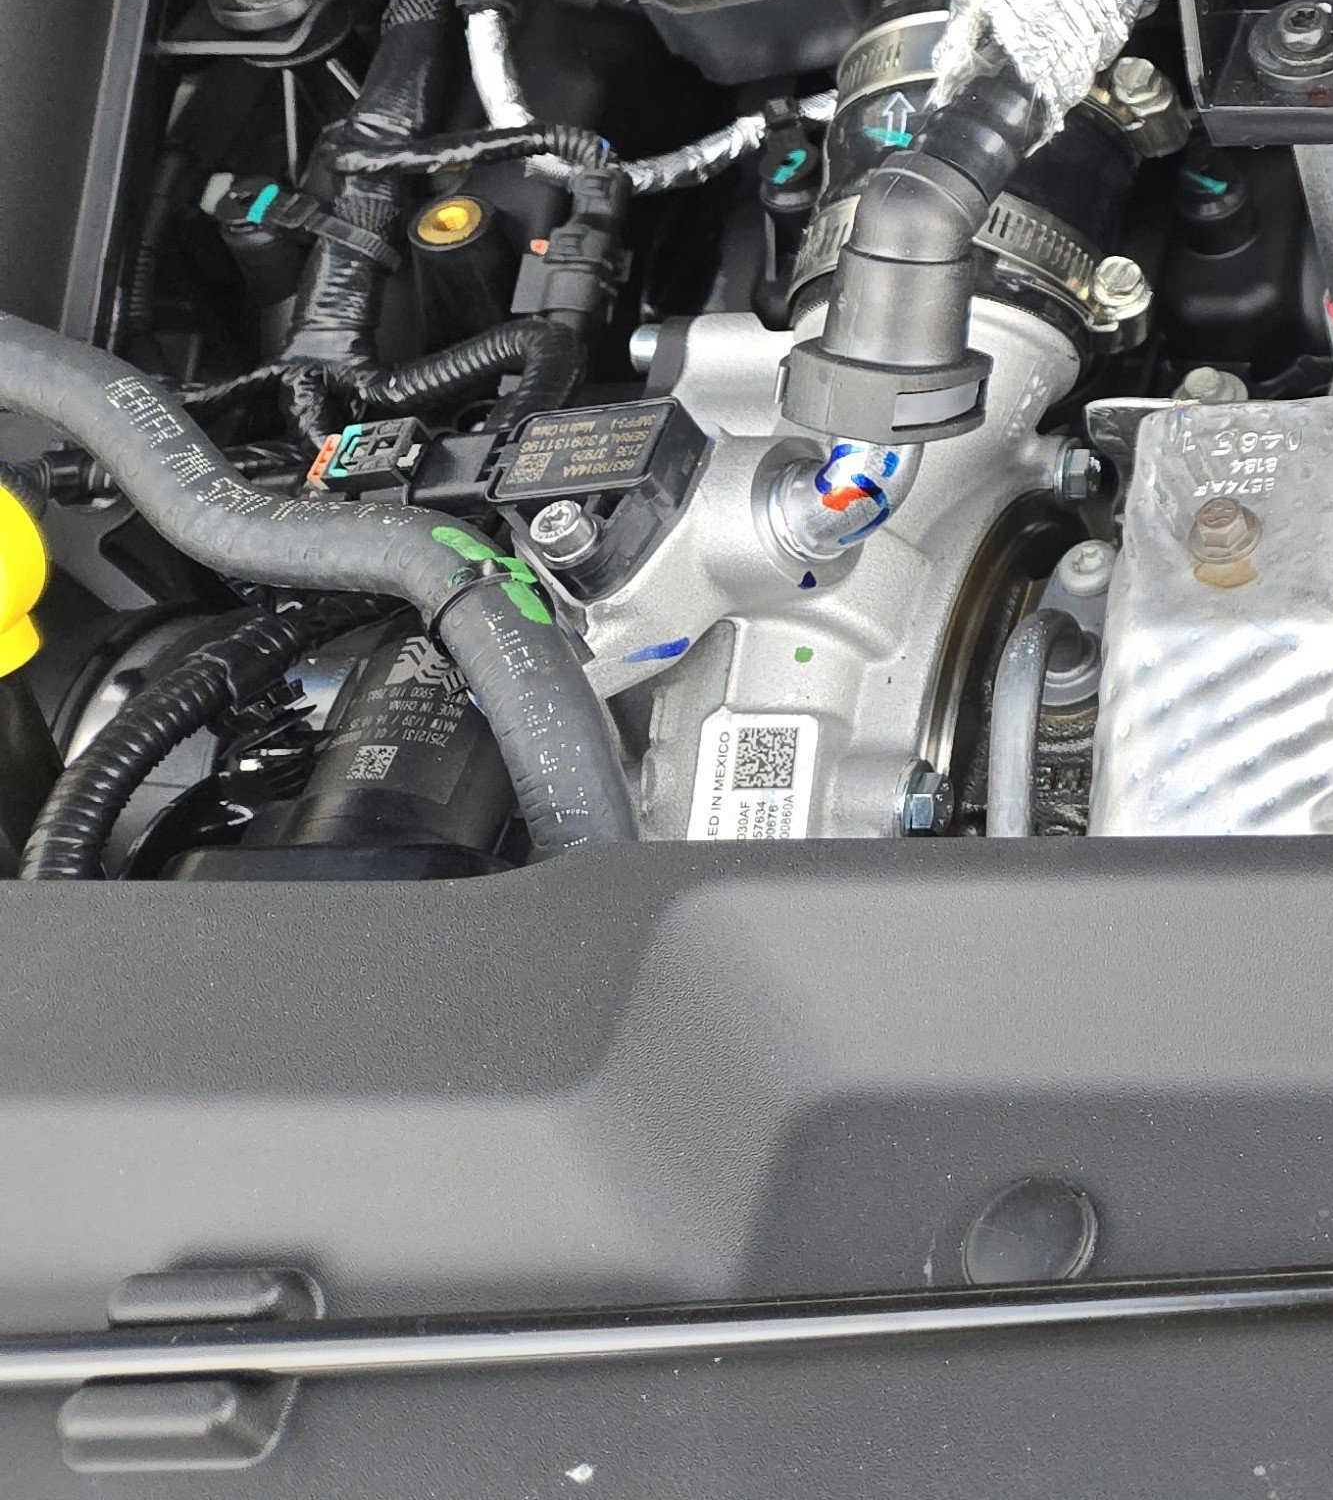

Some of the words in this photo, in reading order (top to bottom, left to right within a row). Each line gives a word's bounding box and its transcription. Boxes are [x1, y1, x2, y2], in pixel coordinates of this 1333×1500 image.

[418, 701, 433, 712] IN
[436, 703, 465, 718] MADE
[712, 730, 731, 791] MEXICO
[710, 796, 721, 810] IN
[708, 815, 719, 835] ED
[752, 801, 766, 837] 57634
